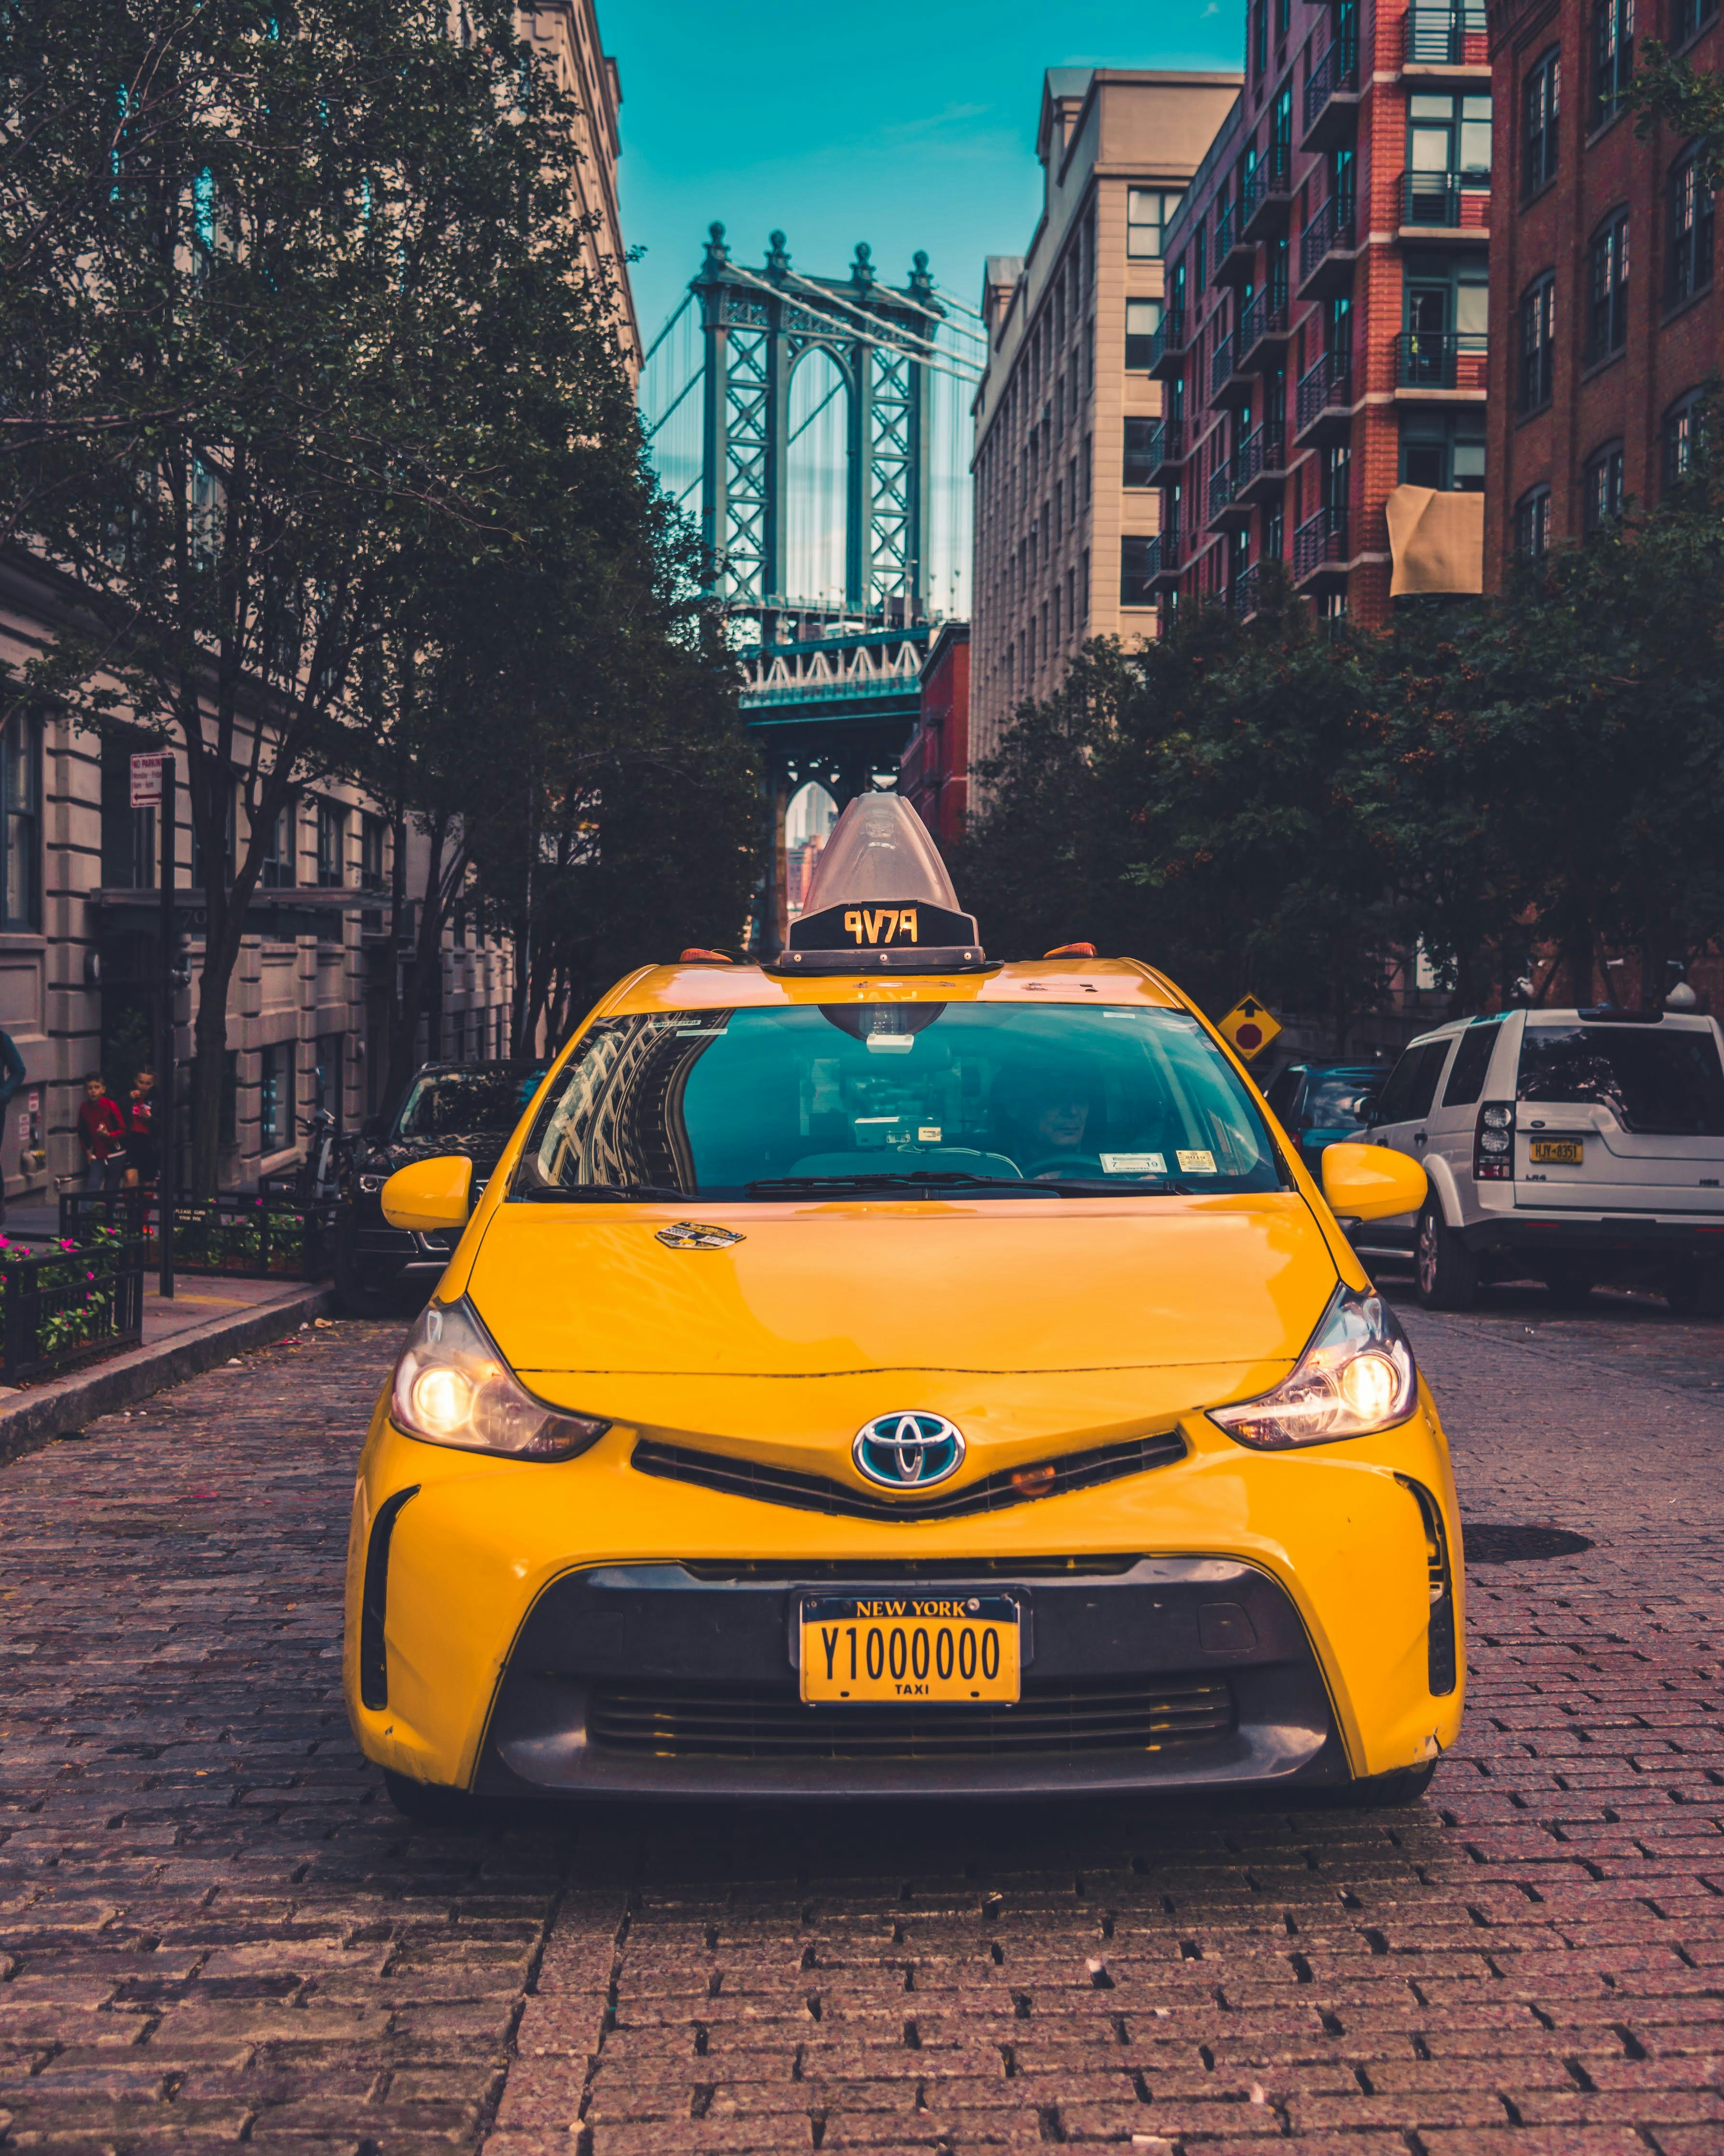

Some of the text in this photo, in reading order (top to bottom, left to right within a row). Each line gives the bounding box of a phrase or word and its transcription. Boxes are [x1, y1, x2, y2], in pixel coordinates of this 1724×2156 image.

[134, 760, 140, 768] NO
[845, 909, 917, 944] 9V79
[857, 1601, 966, 1617] NEW YORK
[822, 1627, 999, 1680] Y1000000
[895, 1685, 929, 1695] TAXI
